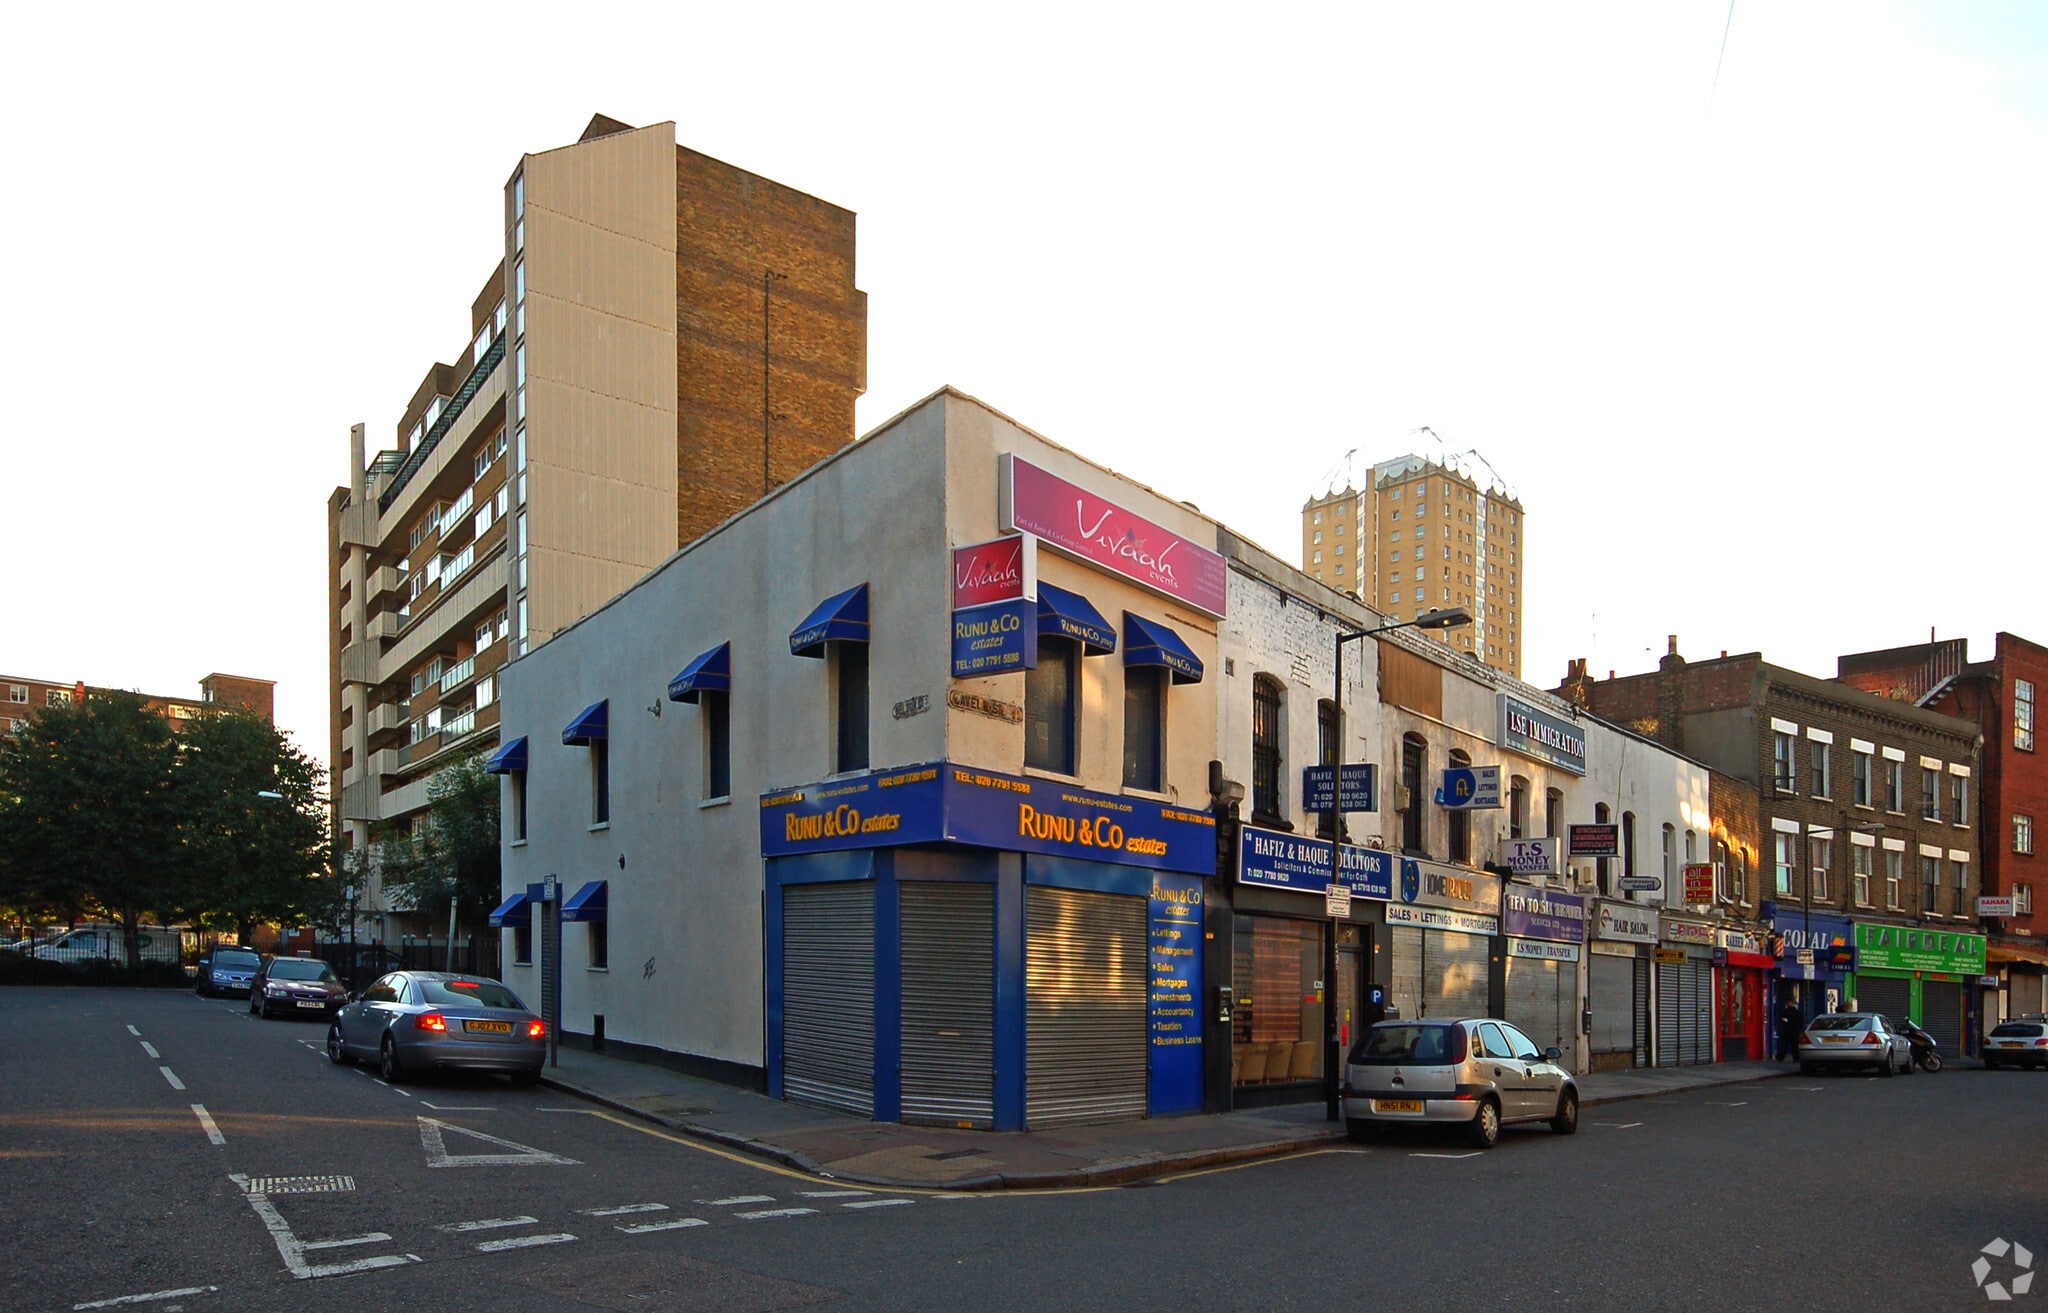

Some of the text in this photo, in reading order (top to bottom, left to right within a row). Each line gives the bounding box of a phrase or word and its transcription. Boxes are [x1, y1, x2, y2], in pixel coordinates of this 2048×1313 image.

[1077, 499, 1178, 580] Vivaah
[956, 544, 1020, 589] Vivaah
[1150, 570, 1178, 589] events
[956, 621, 988, 639] RUNU
[1061, 619, 1081, 635] RUNU
[971, 636, 1005, 650] estates
[956, 660, 971, 670] TEL:
[972, 658, 985, 668] 020
[1511, 711, 1584, 758] LSE IMMIGRATION
[955, 770, 974, 784] TEL:
[975, 775, 991, 787] 020
[992, 778, 1011, 790] 7791
[1311, 770, 1367, 780] HAFIZ HAQUE
[1318, 781, 1360, 790] SOLITORS
[786, 813, 823, 841] RUNU
[862, 814, 900, 833] estates
[1019, 803, 1075, 842] RUNU
[1126, 836, 1167, 856] estates
[1255, 837, 1284, 858] HAFIZ
[1287, 843, 1295, 859] &
[1298, 844, 1329, 866] HAQUE
[1331, 850, 1381, 873] OLICITORS
[1514, 842, 1542, 856] T.S
[1507, 855, 1550, 866] MONEY
[1253, 868, 1263, 878] 020
[1274, 860, 1302, 873] Solicitors
[1308, 865, 1346, 880] Commisser
[1153, 885, 1178, 903] RUNU
[1165, 905, 1190, 916] estates
[1508, 895, 1525, 912] TEN
[1527, 897, 1539, 914] TO
[1540, 900, 1553, 916] SIX
[1554, 903, 1583, 920] TRAVEL
[1389, 908, 1497, 931] SALES LETTINGS MORTGAGES
[1156, 928, 1182, 940] Lettings
[1613, 919, 1649, 935] HAIR SALON
[1156, 945, 1194, 957] Management
[1525, 944, 1542, 955] MONEY
[1547, 946, 1571, 958] TRANSFER
[1157, 962, 1174, 973] Sales
[1156, 978, 1188, 989] Mortgages
[1156, 993, 1192, 1002] Investments
[1373, 990, 1381, 1002] P
[1157, 1008, 1194, 1017] Accountancy
[1157, 1022, 1182, 1031] Taxation
[1157, 1036, 1202, 1045] Business Loans
[1380, 1101, 1398, 1110] HN51
